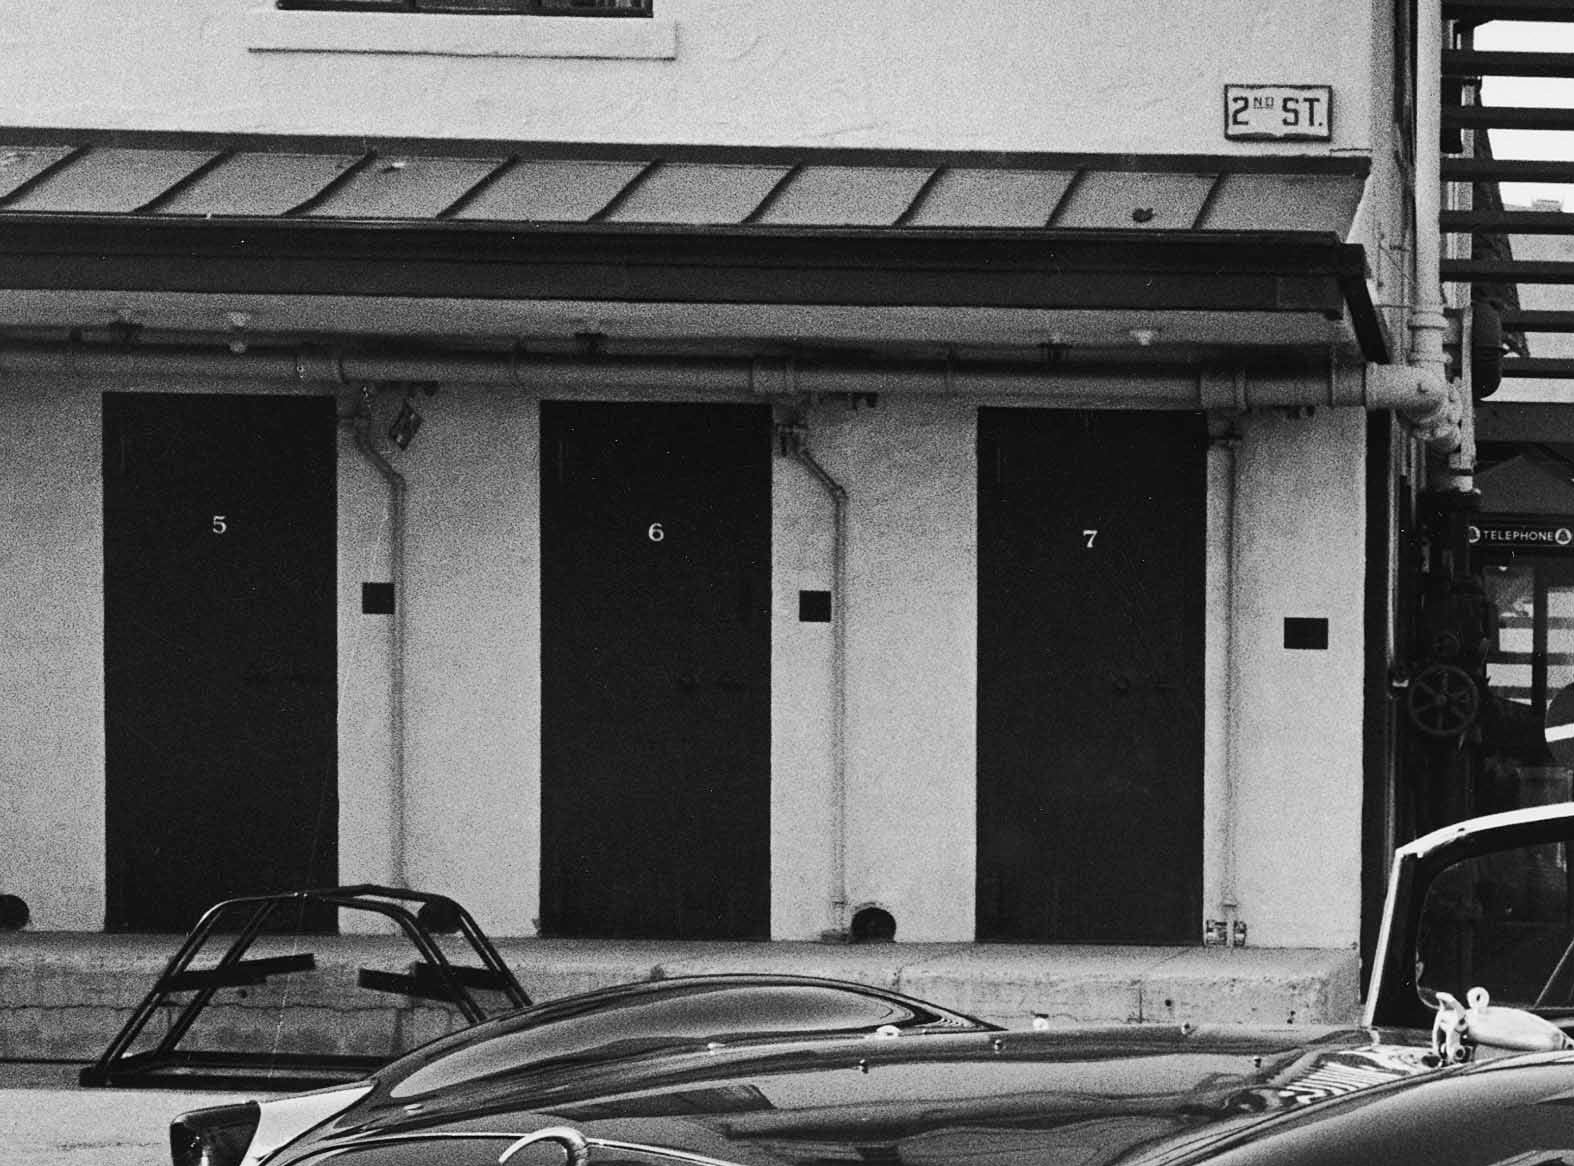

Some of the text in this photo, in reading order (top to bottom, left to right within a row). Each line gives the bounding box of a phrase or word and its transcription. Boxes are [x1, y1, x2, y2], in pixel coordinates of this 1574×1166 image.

[1282, 97, 1322, 126] ST.
[213, 515, 227, 534] 5
[648, 522, 665, 542] 6
[1083, 529, 1098, 549] 7
[1483, 530, 1553, 541] TELEPHONE
